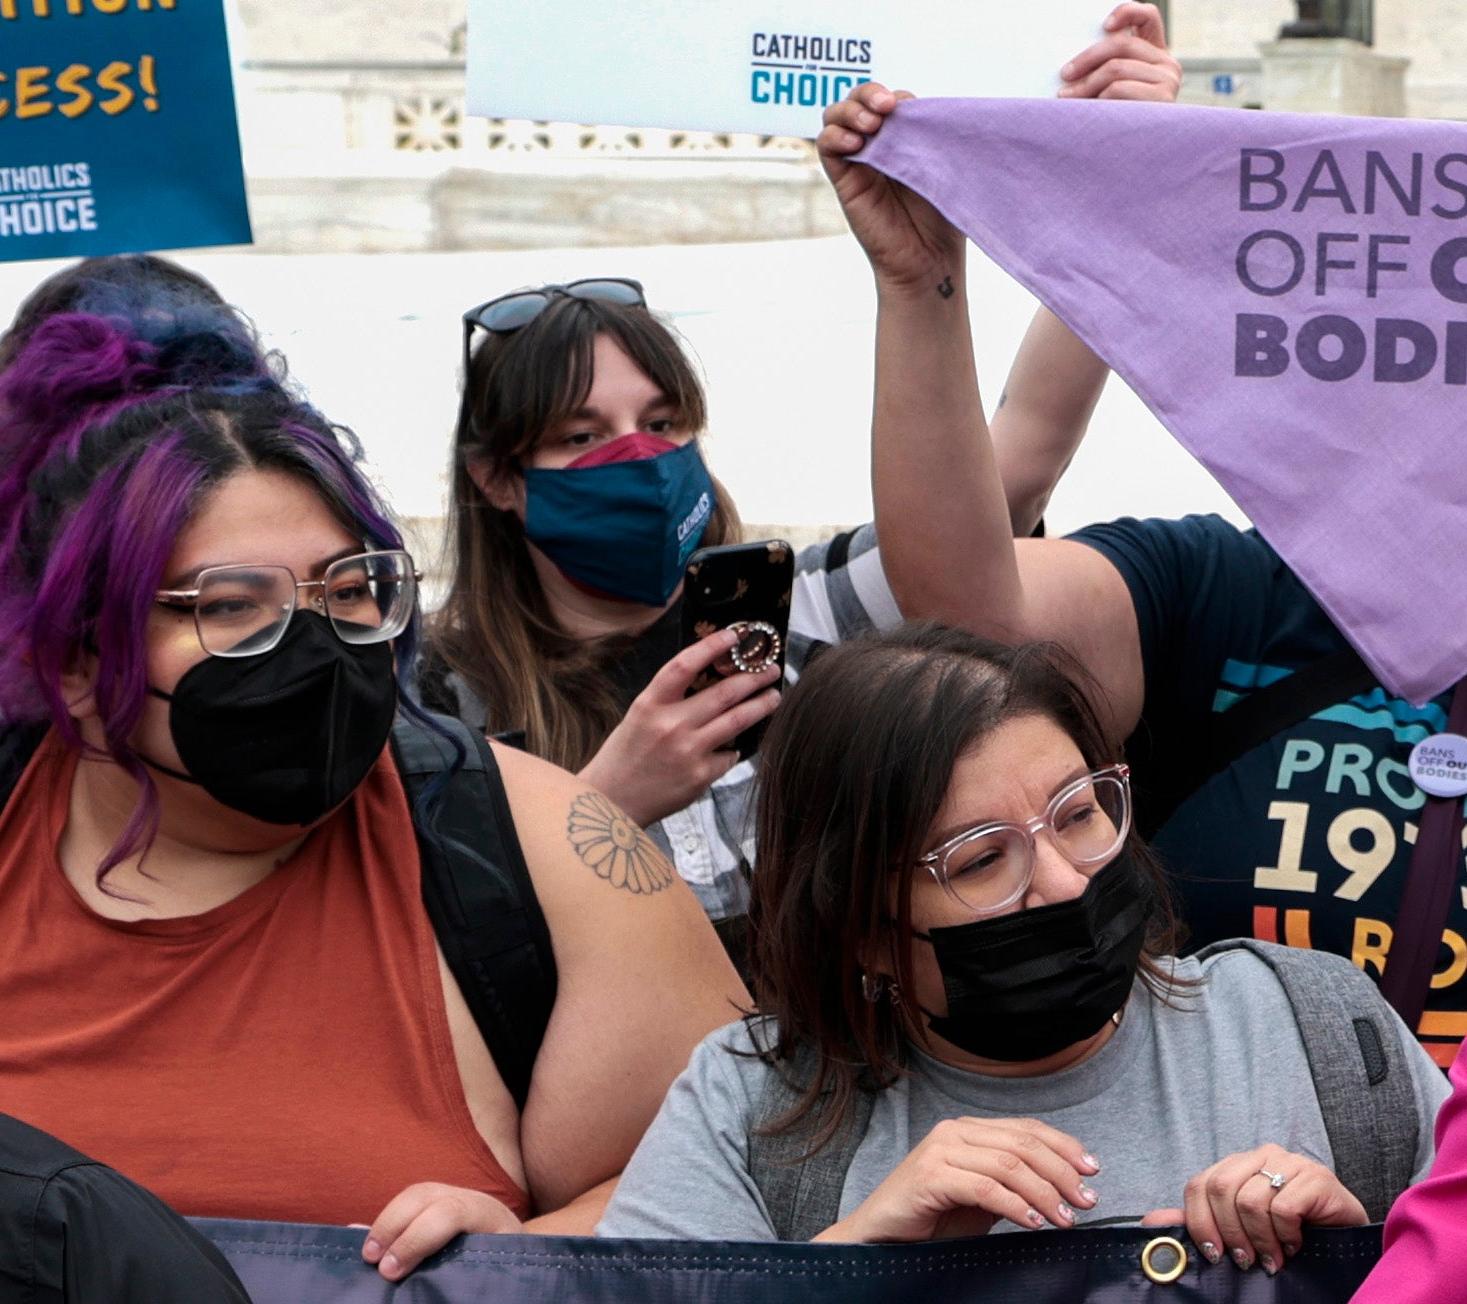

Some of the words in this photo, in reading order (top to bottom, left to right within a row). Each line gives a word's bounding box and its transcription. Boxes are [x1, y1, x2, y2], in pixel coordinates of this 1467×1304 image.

[752, 32, 872, 64] CATHOLICS
[751, 70, 872, 107] CHOIC
[1234, 229, 1412, 298] OFF
[1419, 746, 1455, 759] BANS
[1416, 766, 1467, 781] BODIES
